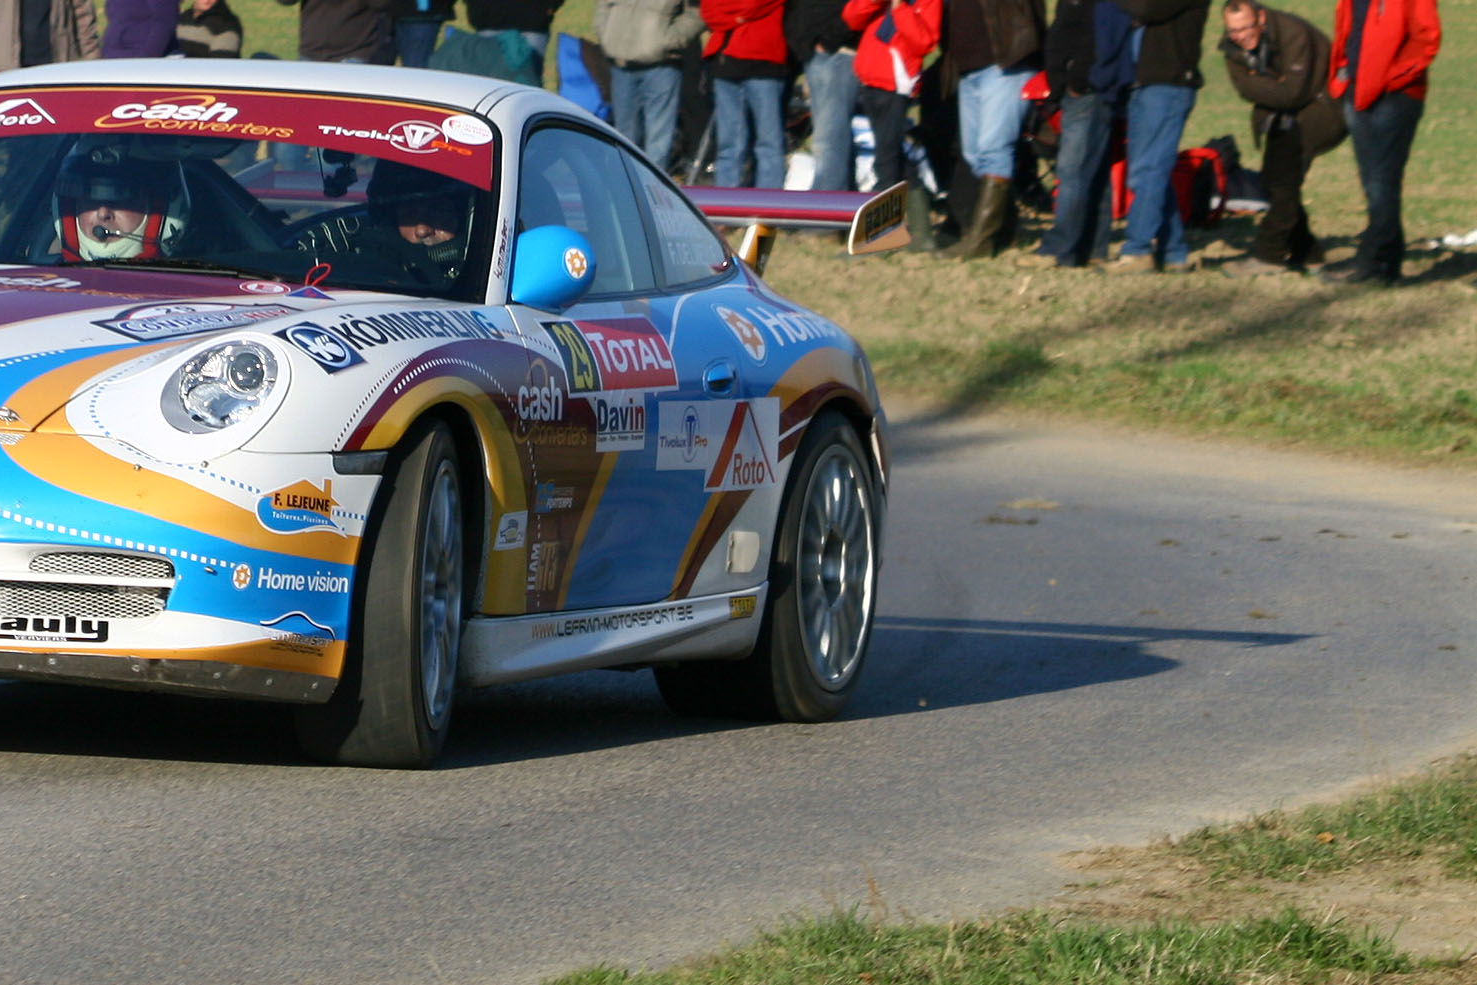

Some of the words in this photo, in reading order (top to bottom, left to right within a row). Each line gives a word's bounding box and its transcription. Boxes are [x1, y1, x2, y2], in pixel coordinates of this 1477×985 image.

[112, 102, 239, 122] cash
[145, 119, 295, 138] converters
[318, 124, 405, 143] Tivolux
[431, 141, 473, 156] Pro
[330, 310, 505, 350] KÖMMERLING
[585, 332, 673, 373] TOTAL
[518, 376, 563, 422] cash
[597, 398, 644, 432] Davin
[533, 424, 589, 446] converters
[732, 454, 765, 486] Roto
[274, 493, 283, 507] F.
[287, 495, 330, 512] LEJEUNE
[257, 567, 305, 591] Home
[307, 571, 348, 593] vision
